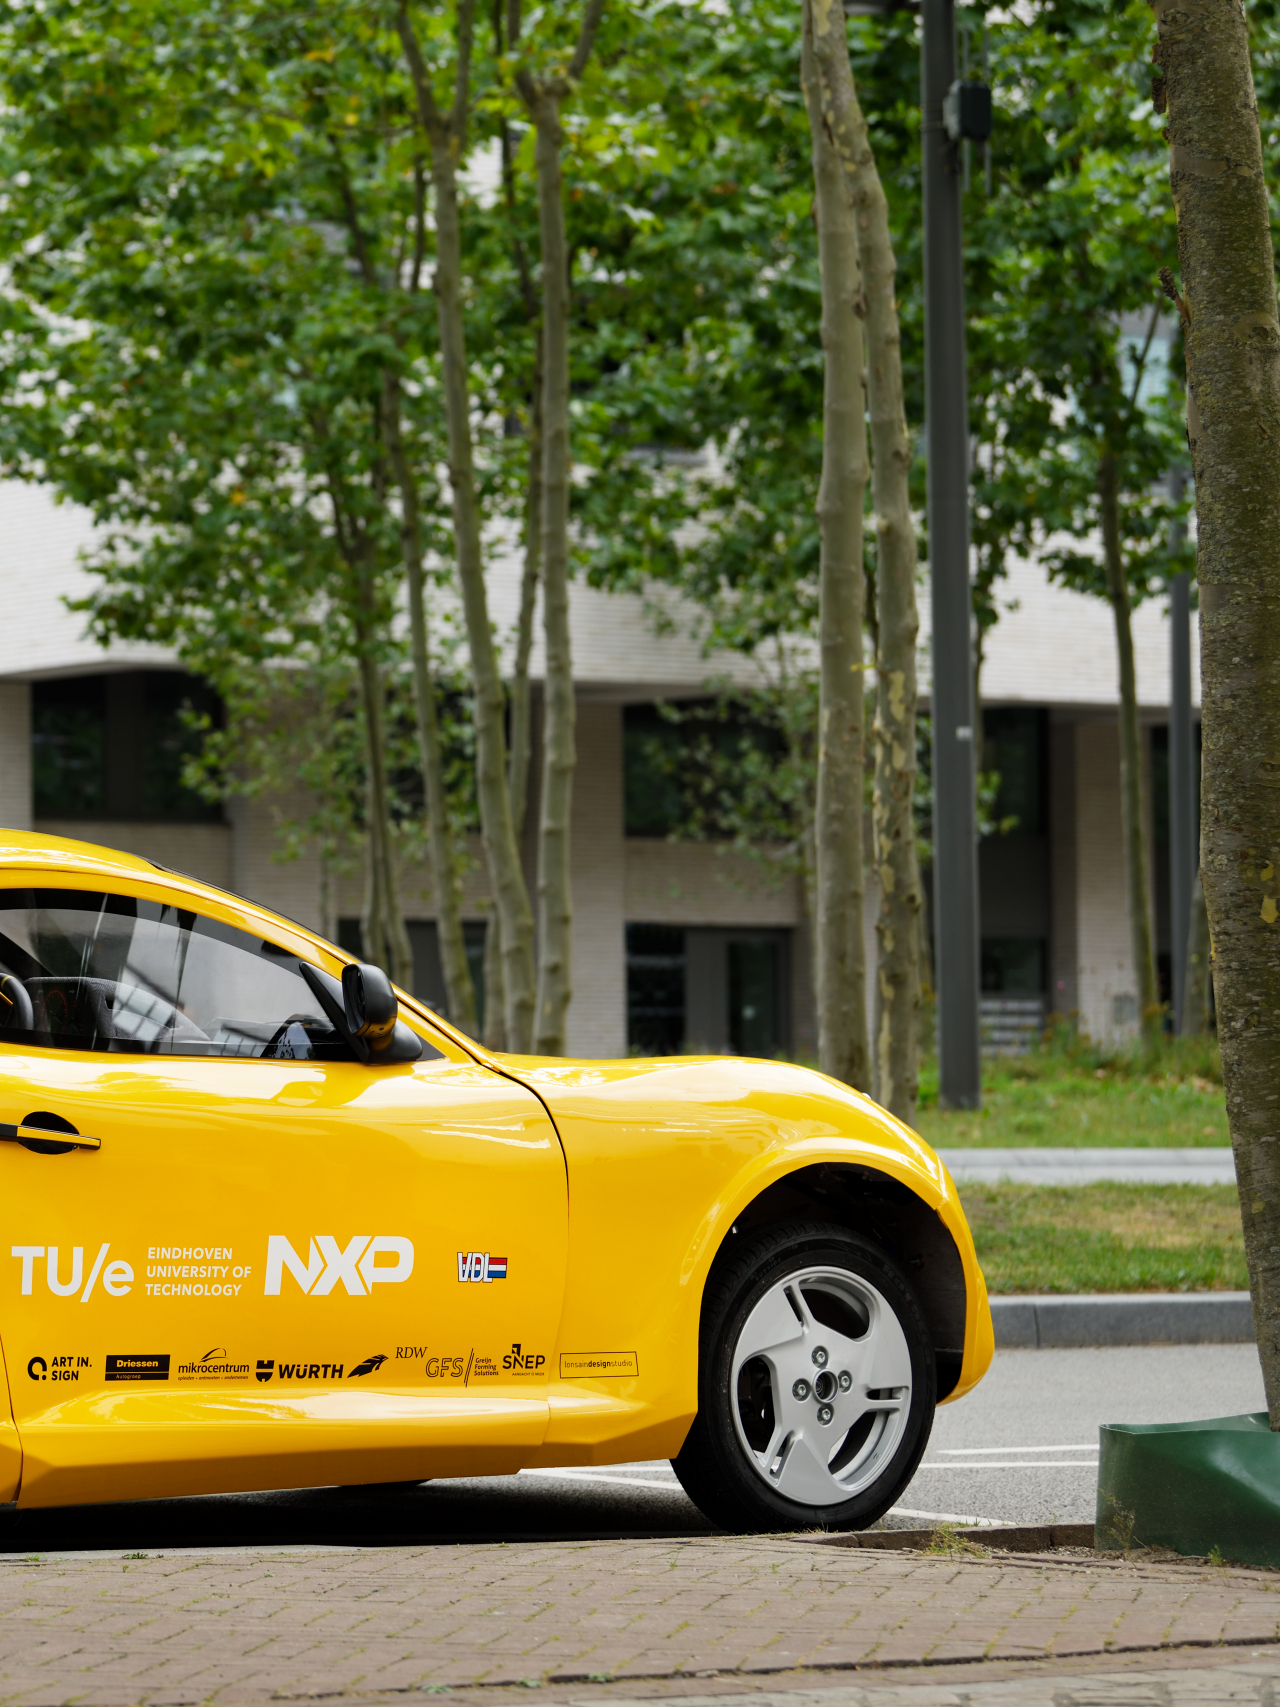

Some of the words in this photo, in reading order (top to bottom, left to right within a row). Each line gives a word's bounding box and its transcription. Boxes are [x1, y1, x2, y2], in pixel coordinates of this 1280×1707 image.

[147, 1247, 233, 1260] EINDHOVEN
[264, 1235, 414, 1295] NXP
[457, 1252, 493, 1283] VDL
[11, 1243, 134, 1303] TU/e
[146, 1266, 229, 1278] UNIVERSITY
[232, 1266, 252, 1278] OF
[145, 1284, 242, 1296] TECHNOLOGY
[395, 1347, 428, 1359] RDW
[52, 1357, 73, 1367] ART
[77, 1357, 92, 1367] IN.
[117, 1360, 158, 1368] Driessen
[178, 1362, 250, 1373] mikrocentrum
[425, 1358, 464, 1378] GFS
[502, 1355, 546, 1369] SNEP
[51, 1371, 79, 1381] SIGN
